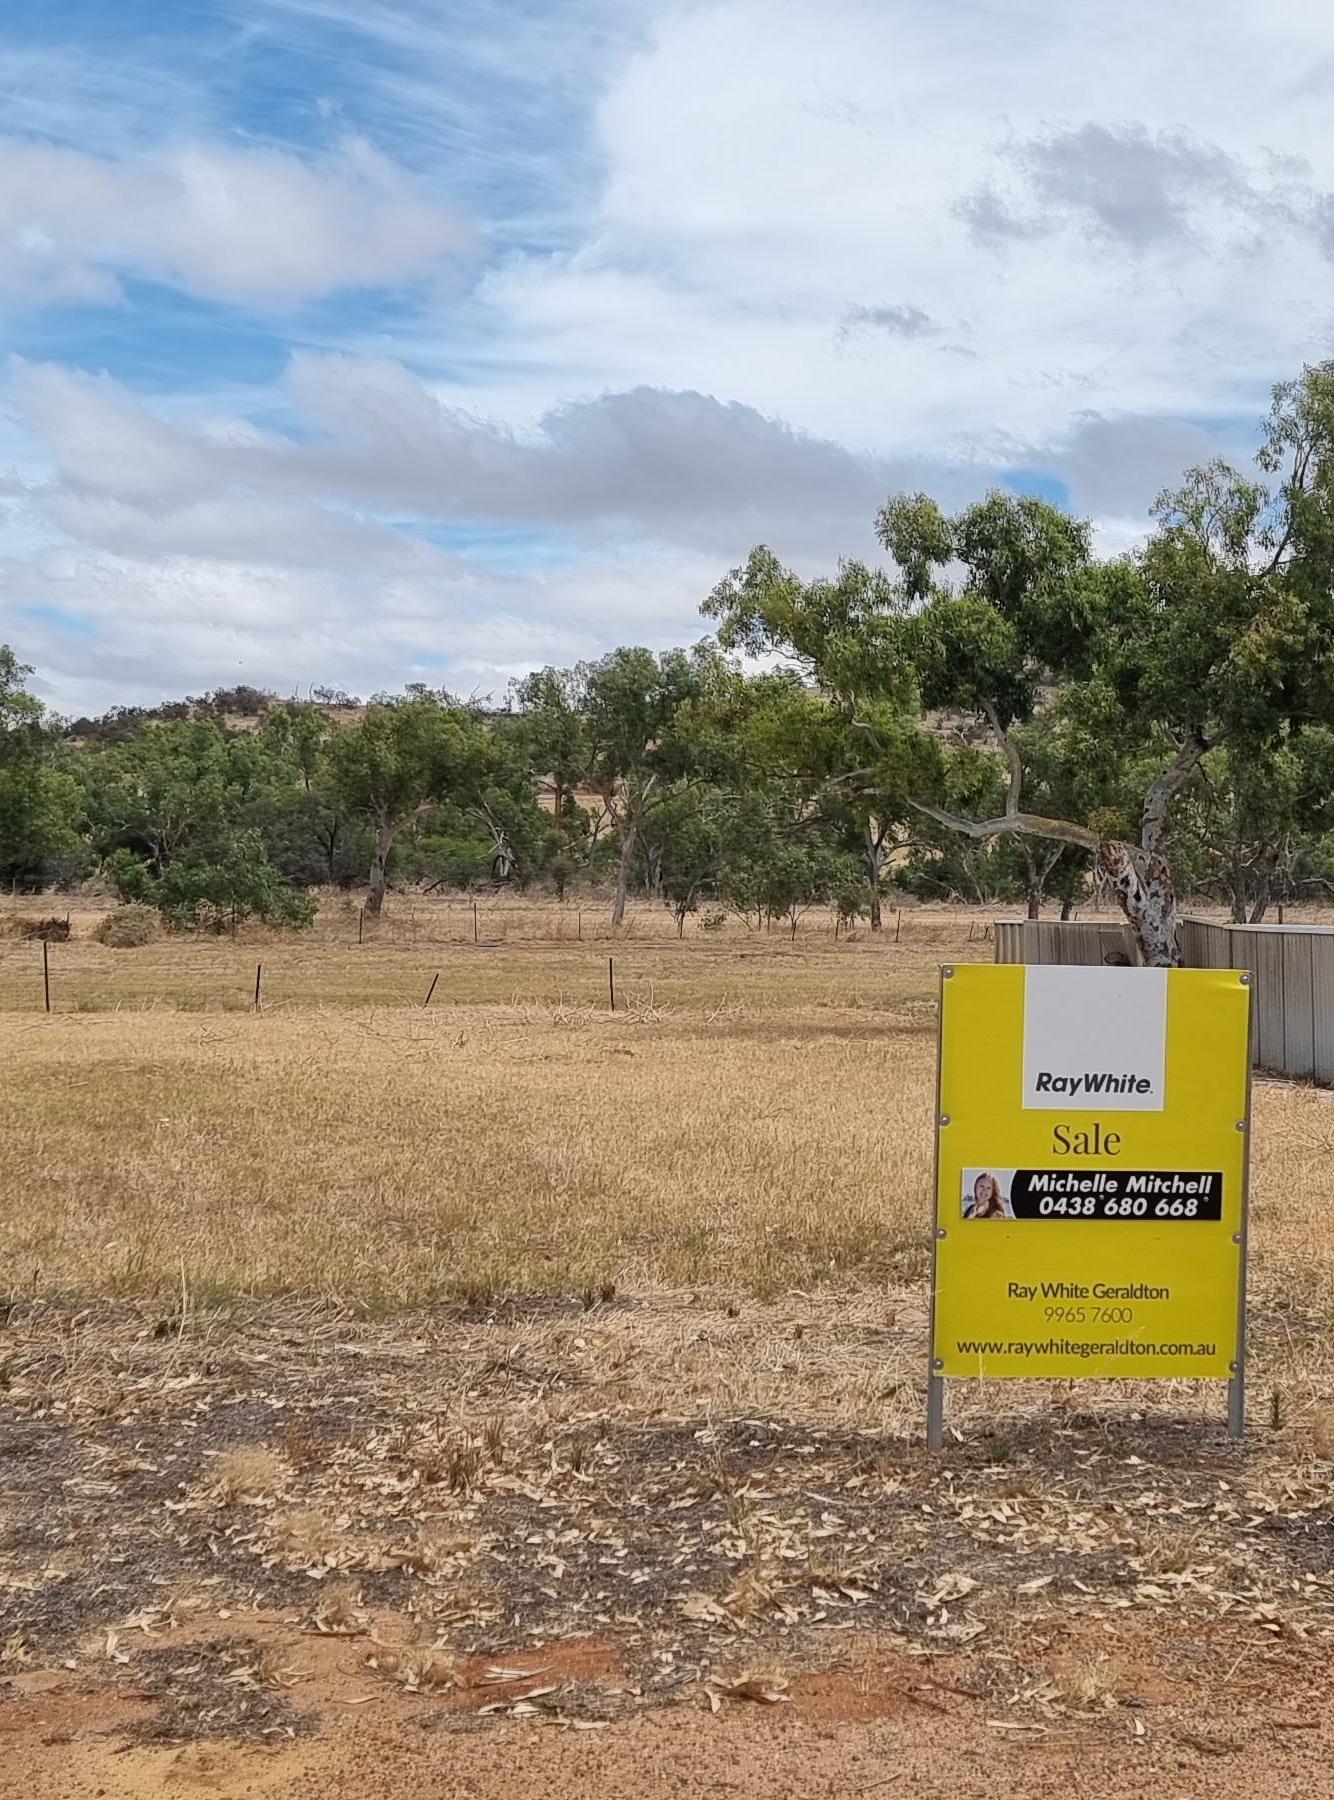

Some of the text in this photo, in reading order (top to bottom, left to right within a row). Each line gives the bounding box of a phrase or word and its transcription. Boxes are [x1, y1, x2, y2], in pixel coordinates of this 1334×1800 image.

[1052, 1123, 1122, 1155] Sale
[1028, 1174, 1212, 1194] Michelle Mitchell
[1039, 1197, 1198, 1216] 0438 680 668
[1008, 1283, 1169, 1301] Ray White Geraldton
[1044, 1307, 1133, 1323] 9965 7600
[957, 1339, 1216, 1358] www.raywhitegeraldton.com.au
